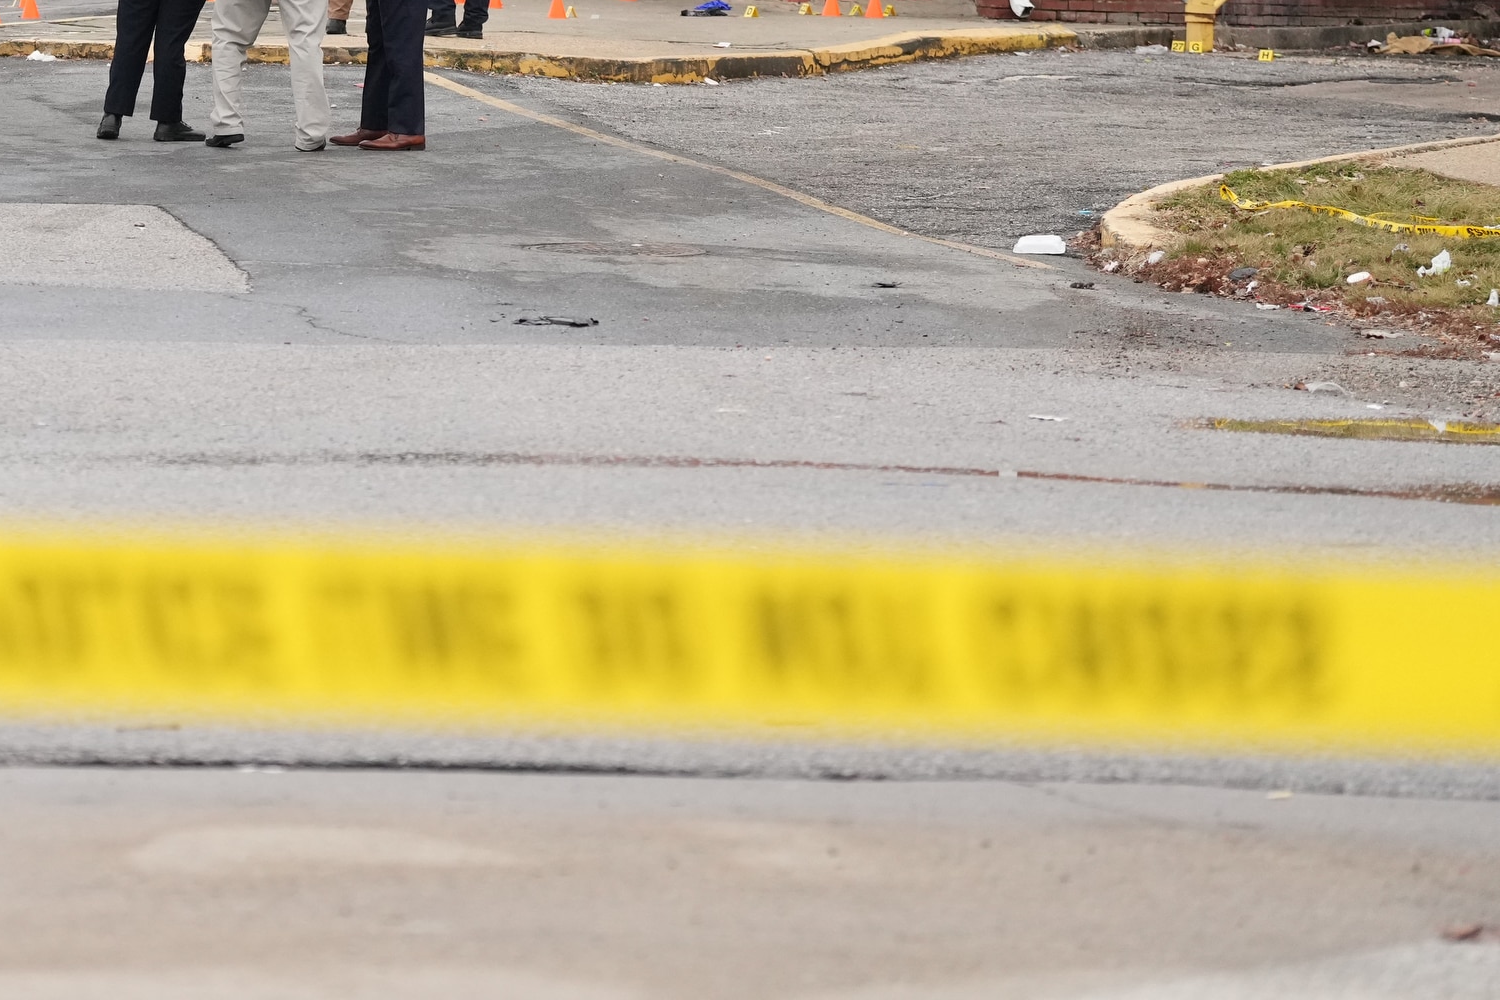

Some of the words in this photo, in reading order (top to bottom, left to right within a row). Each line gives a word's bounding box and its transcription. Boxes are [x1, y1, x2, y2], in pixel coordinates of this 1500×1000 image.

[1172, 42, 1184, 50] 27
[1191, 43, 1200, 51] G
[1261, 51, 1270, 59] H
